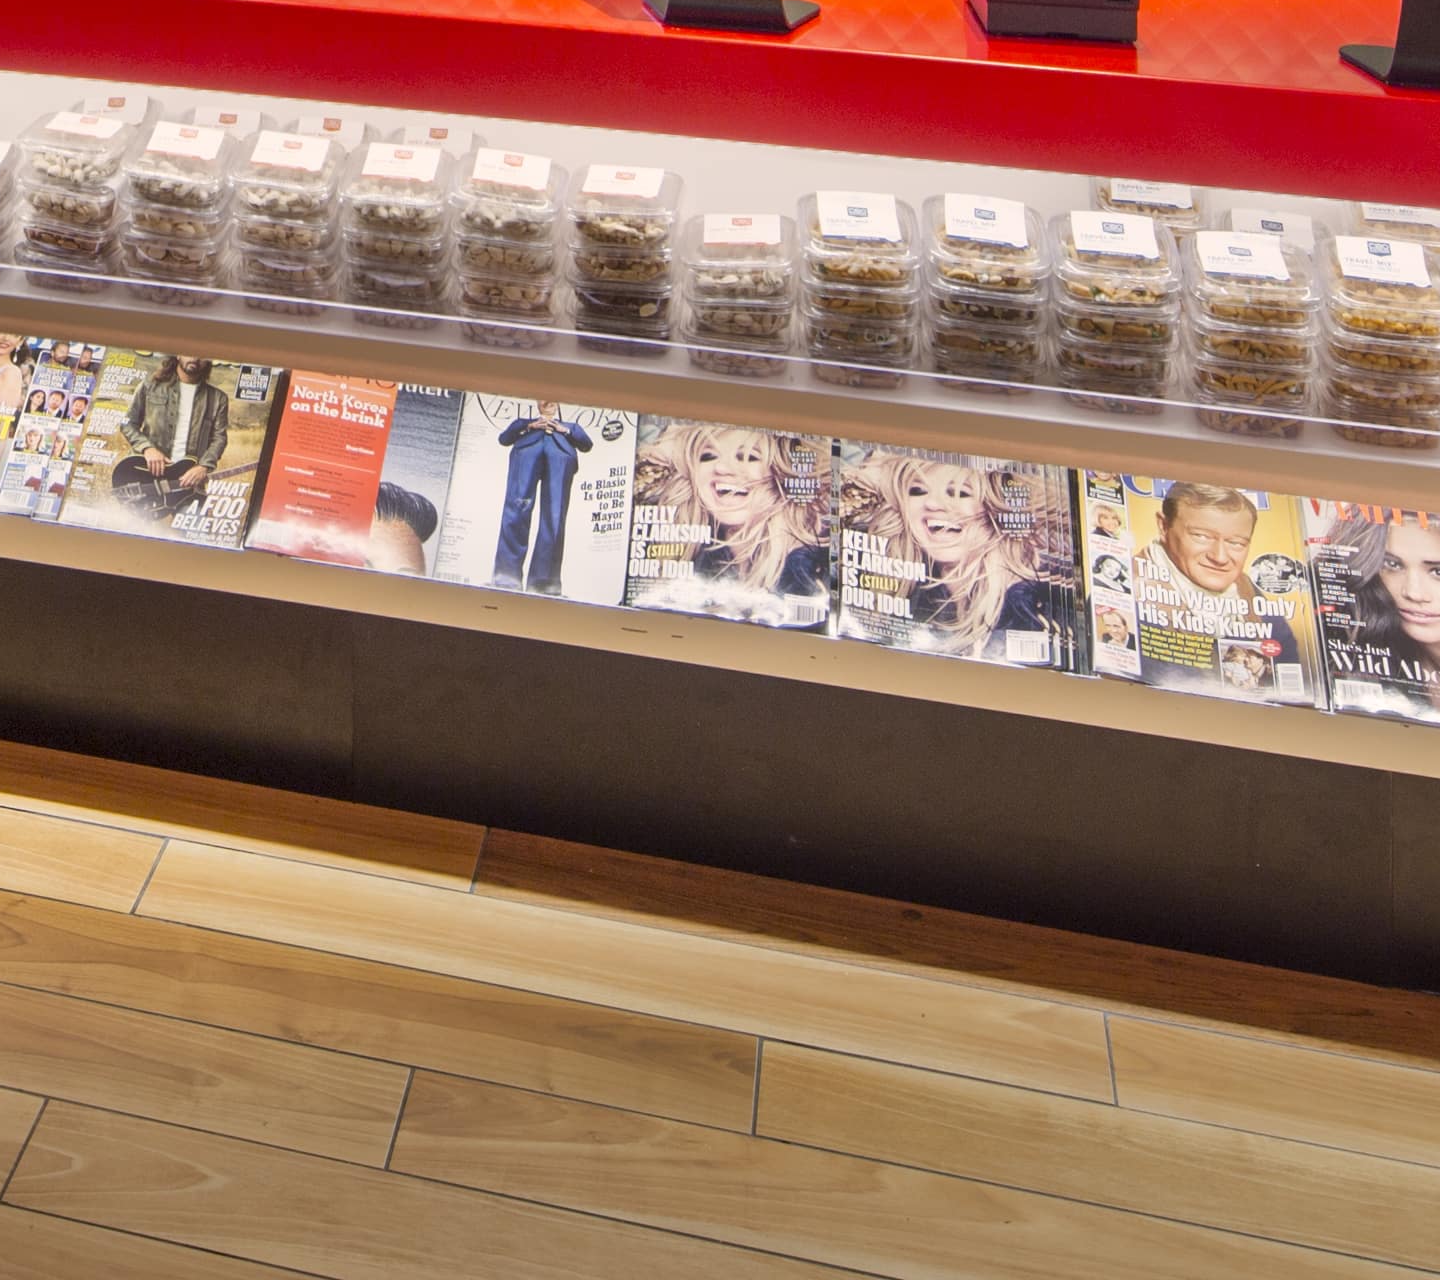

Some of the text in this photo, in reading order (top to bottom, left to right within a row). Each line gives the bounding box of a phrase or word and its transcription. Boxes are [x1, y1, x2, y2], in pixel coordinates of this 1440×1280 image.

[292, 385, 388, 416] North Korea
[290, 401, 385, 428] on the brink
[205, 480, 249, 498] WHAT
[202, 496, 245, 519] FOO
[591, 510, 624, 523] Mayor
[634, 506, 676, 525] KELLY
[172, 514, 240, 535] BELIEVES
[593, 521, 622, 535] Again
[632, 524, 711, 544] CLARKSON
[1136, 557, 1170, 581] The
[1138, 583, 1296, 621] John Wayne Only
[1139, 604, 1272, 639] His Kids Knew
[1329, 651, 1391, 677] Wild
